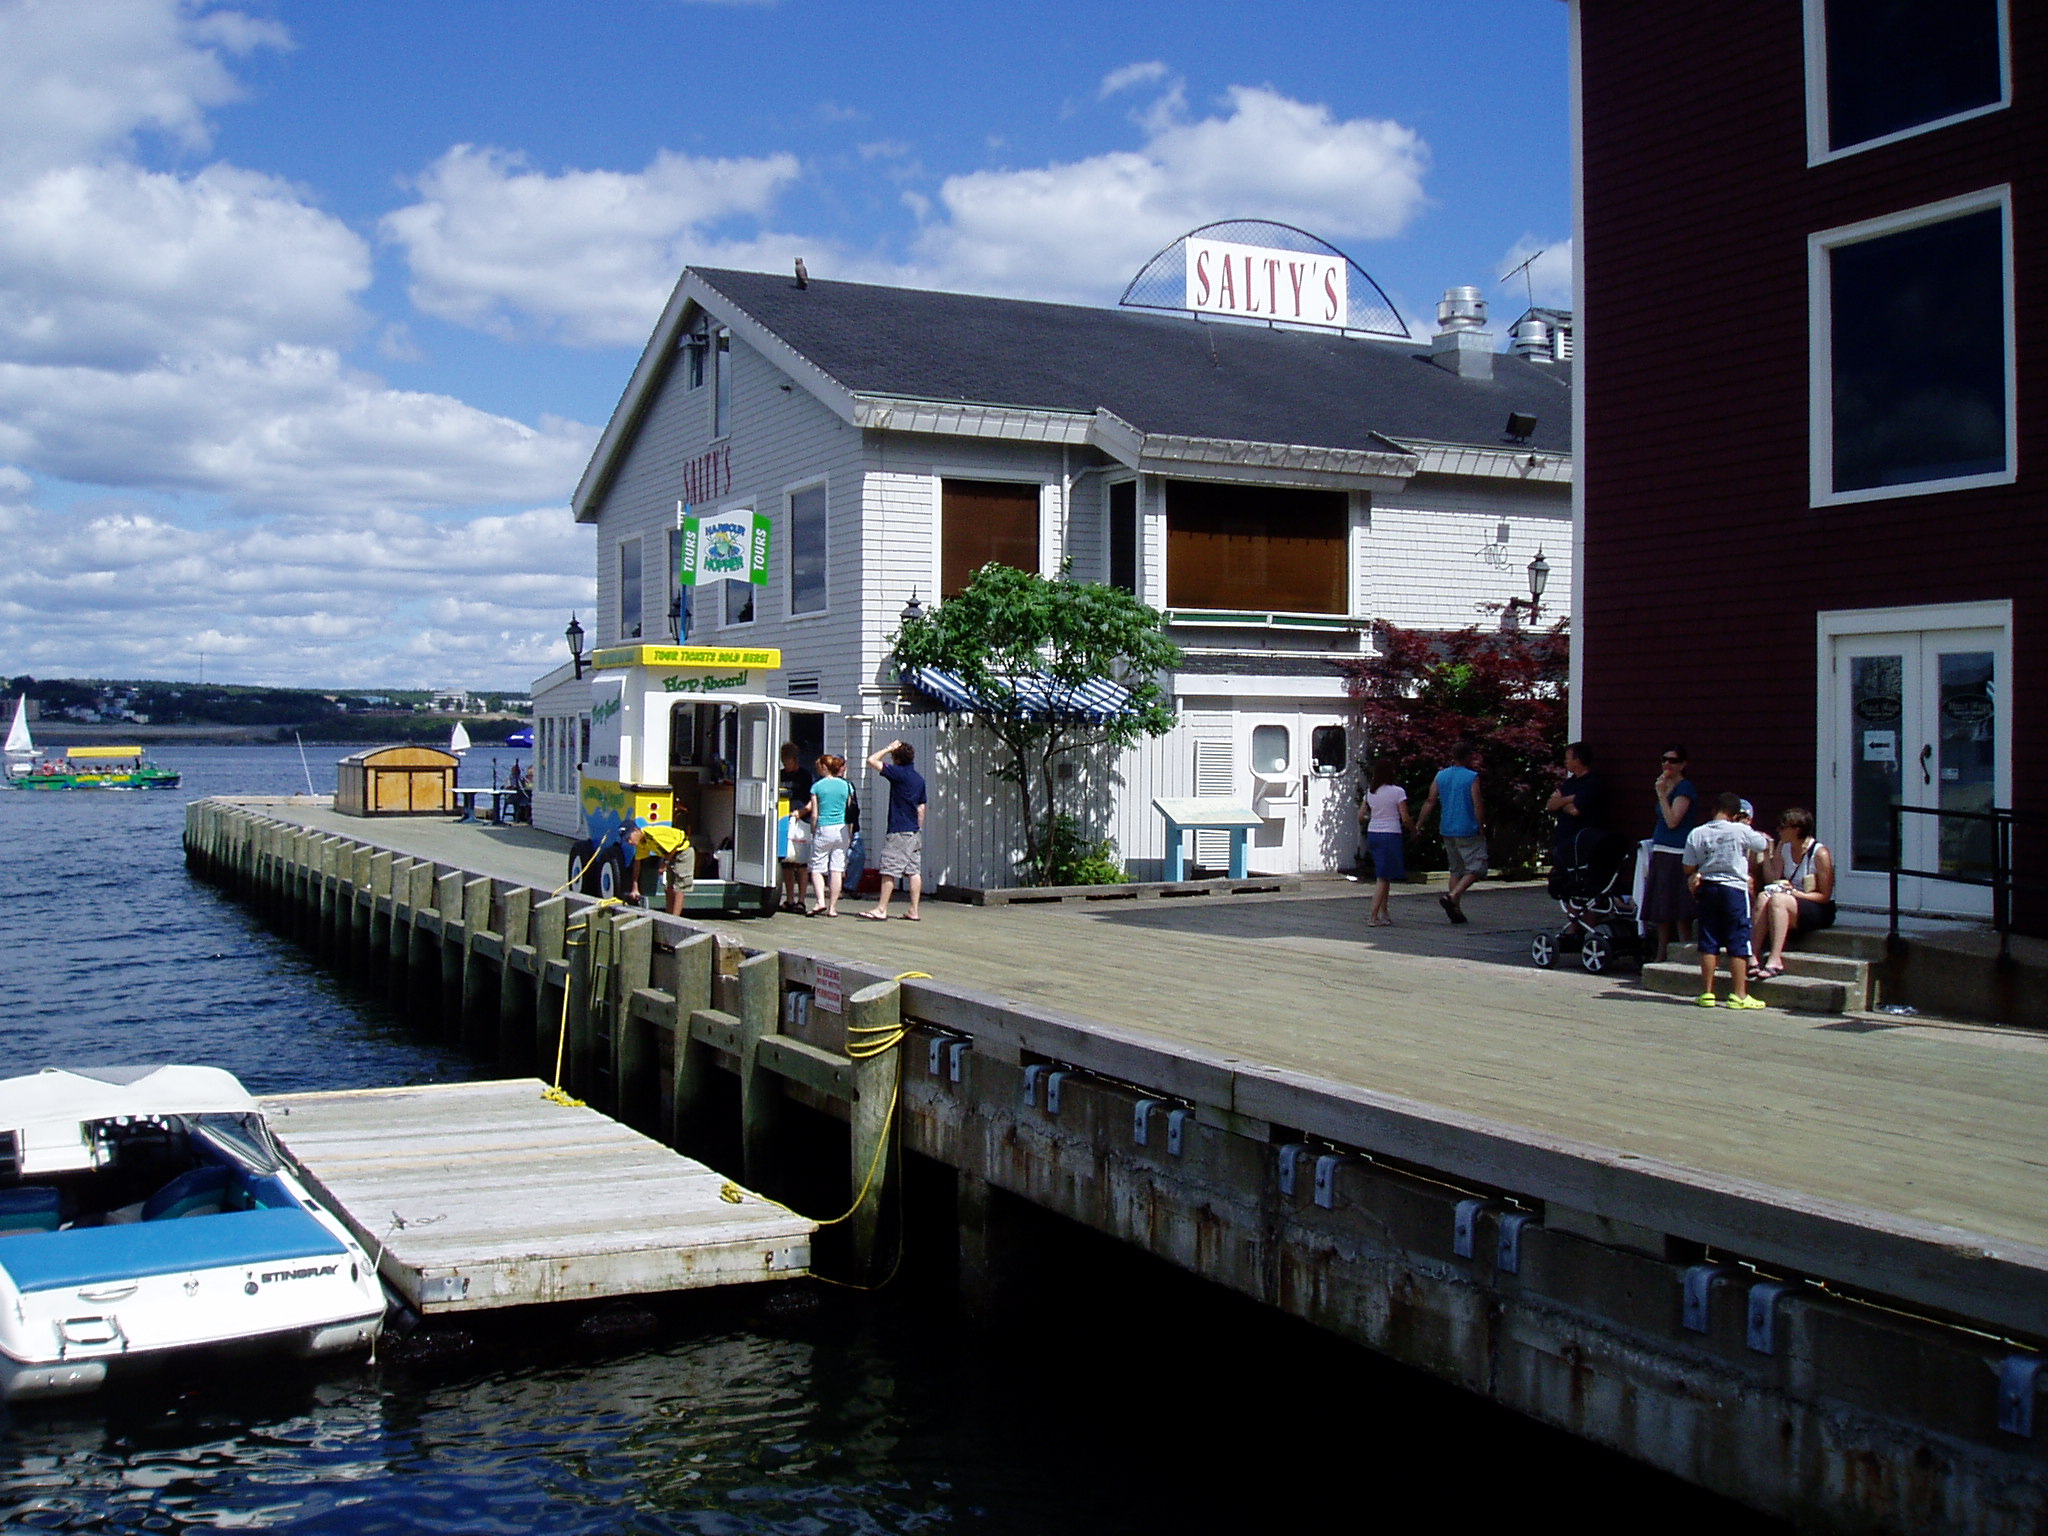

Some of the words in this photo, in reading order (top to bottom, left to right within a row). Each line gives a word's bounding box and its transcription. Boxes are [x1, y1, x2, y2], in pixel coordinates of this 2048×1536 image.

[1197, 250, 1337, 321] SALTY'S
[683, 445, 731, 505] SALTY'S
[683, 530, 697, 572] TOURS
[753, 528, 767, 571] TOURS
[680, 651, 717, 663] TICKETS
[662, 674, 700, 693] Hop
[701, 670, 748, 693] Aboard!
[261, 1265, 338, 1283] STINGRAY
